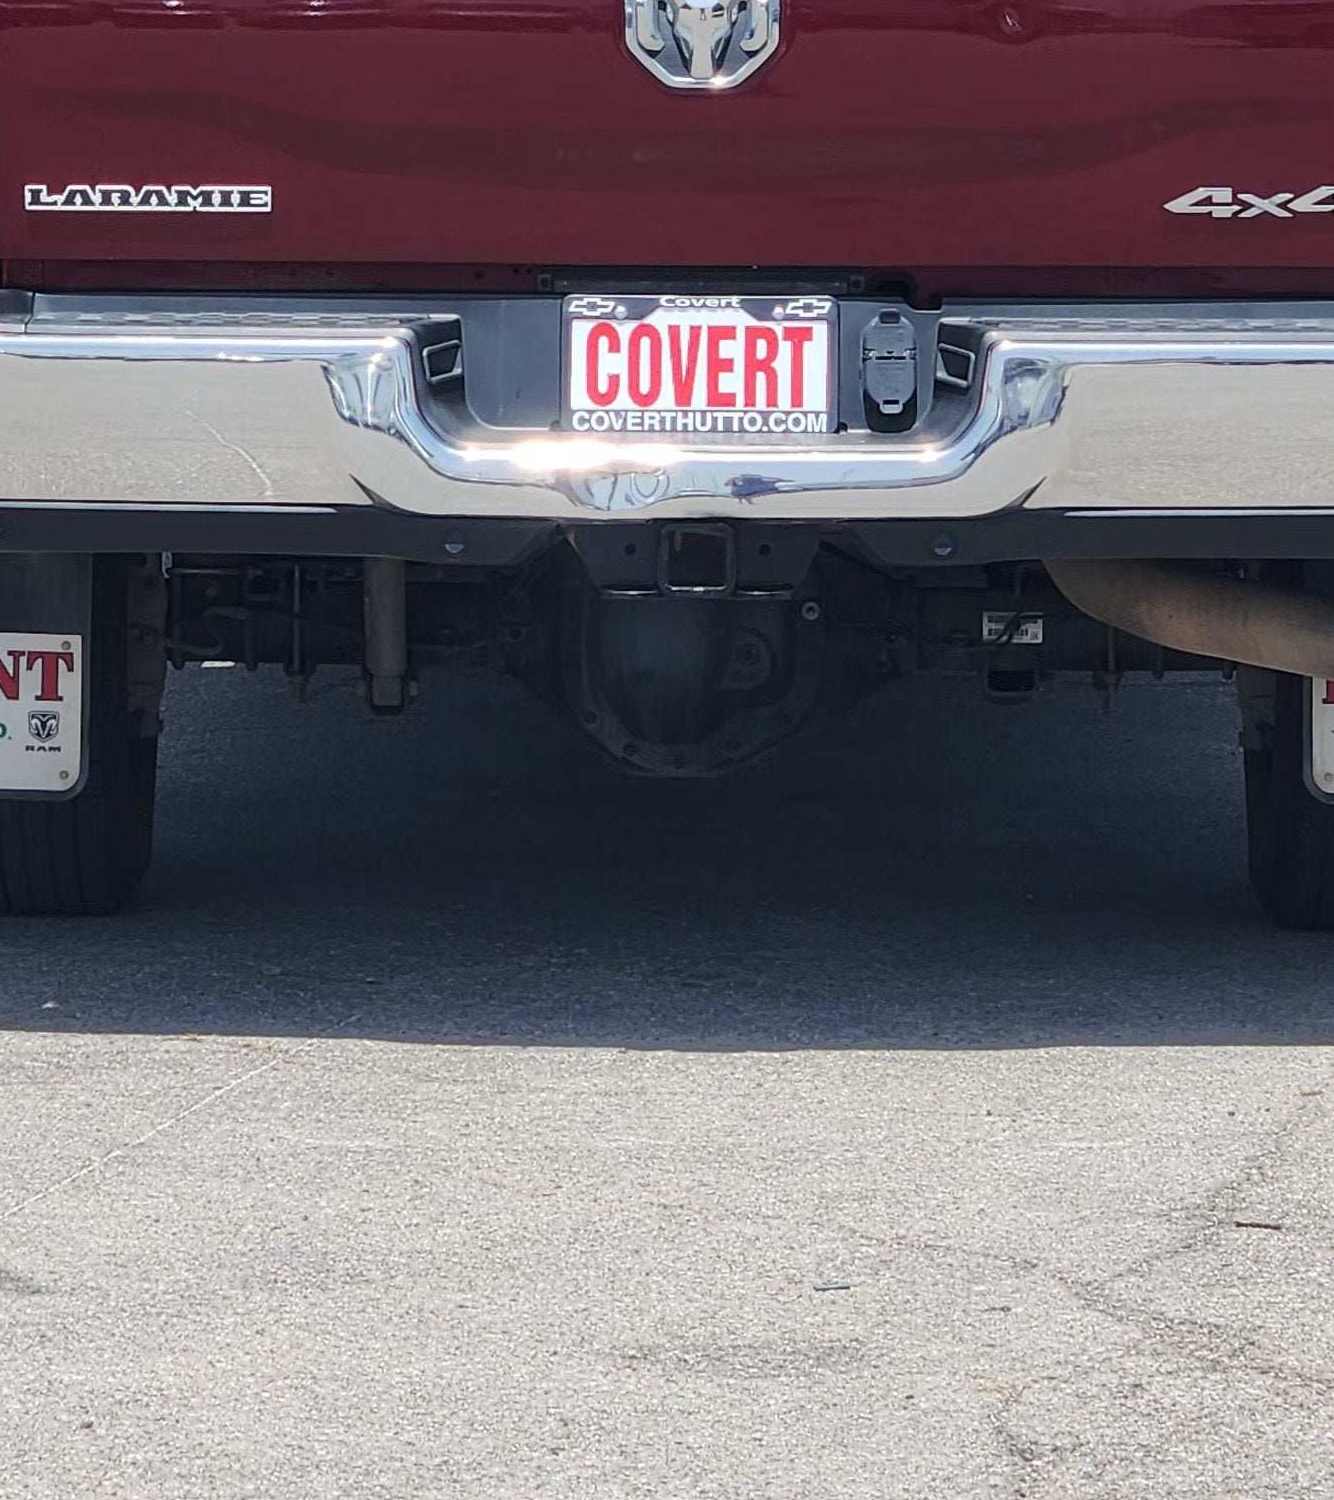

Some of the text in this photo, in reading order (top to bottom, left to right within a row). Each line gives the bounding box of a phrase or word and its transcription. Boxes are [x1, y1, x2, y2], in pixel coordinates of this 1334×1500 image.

[24, 184, 272, 213] LARAMIE
[660, 295, 741, 309] Covert
[586, 321, 813, 408] COVERT
[572, 410, 827, 433] COVERTHUTTO.COM
[25, 745, 61, 753] RAM
